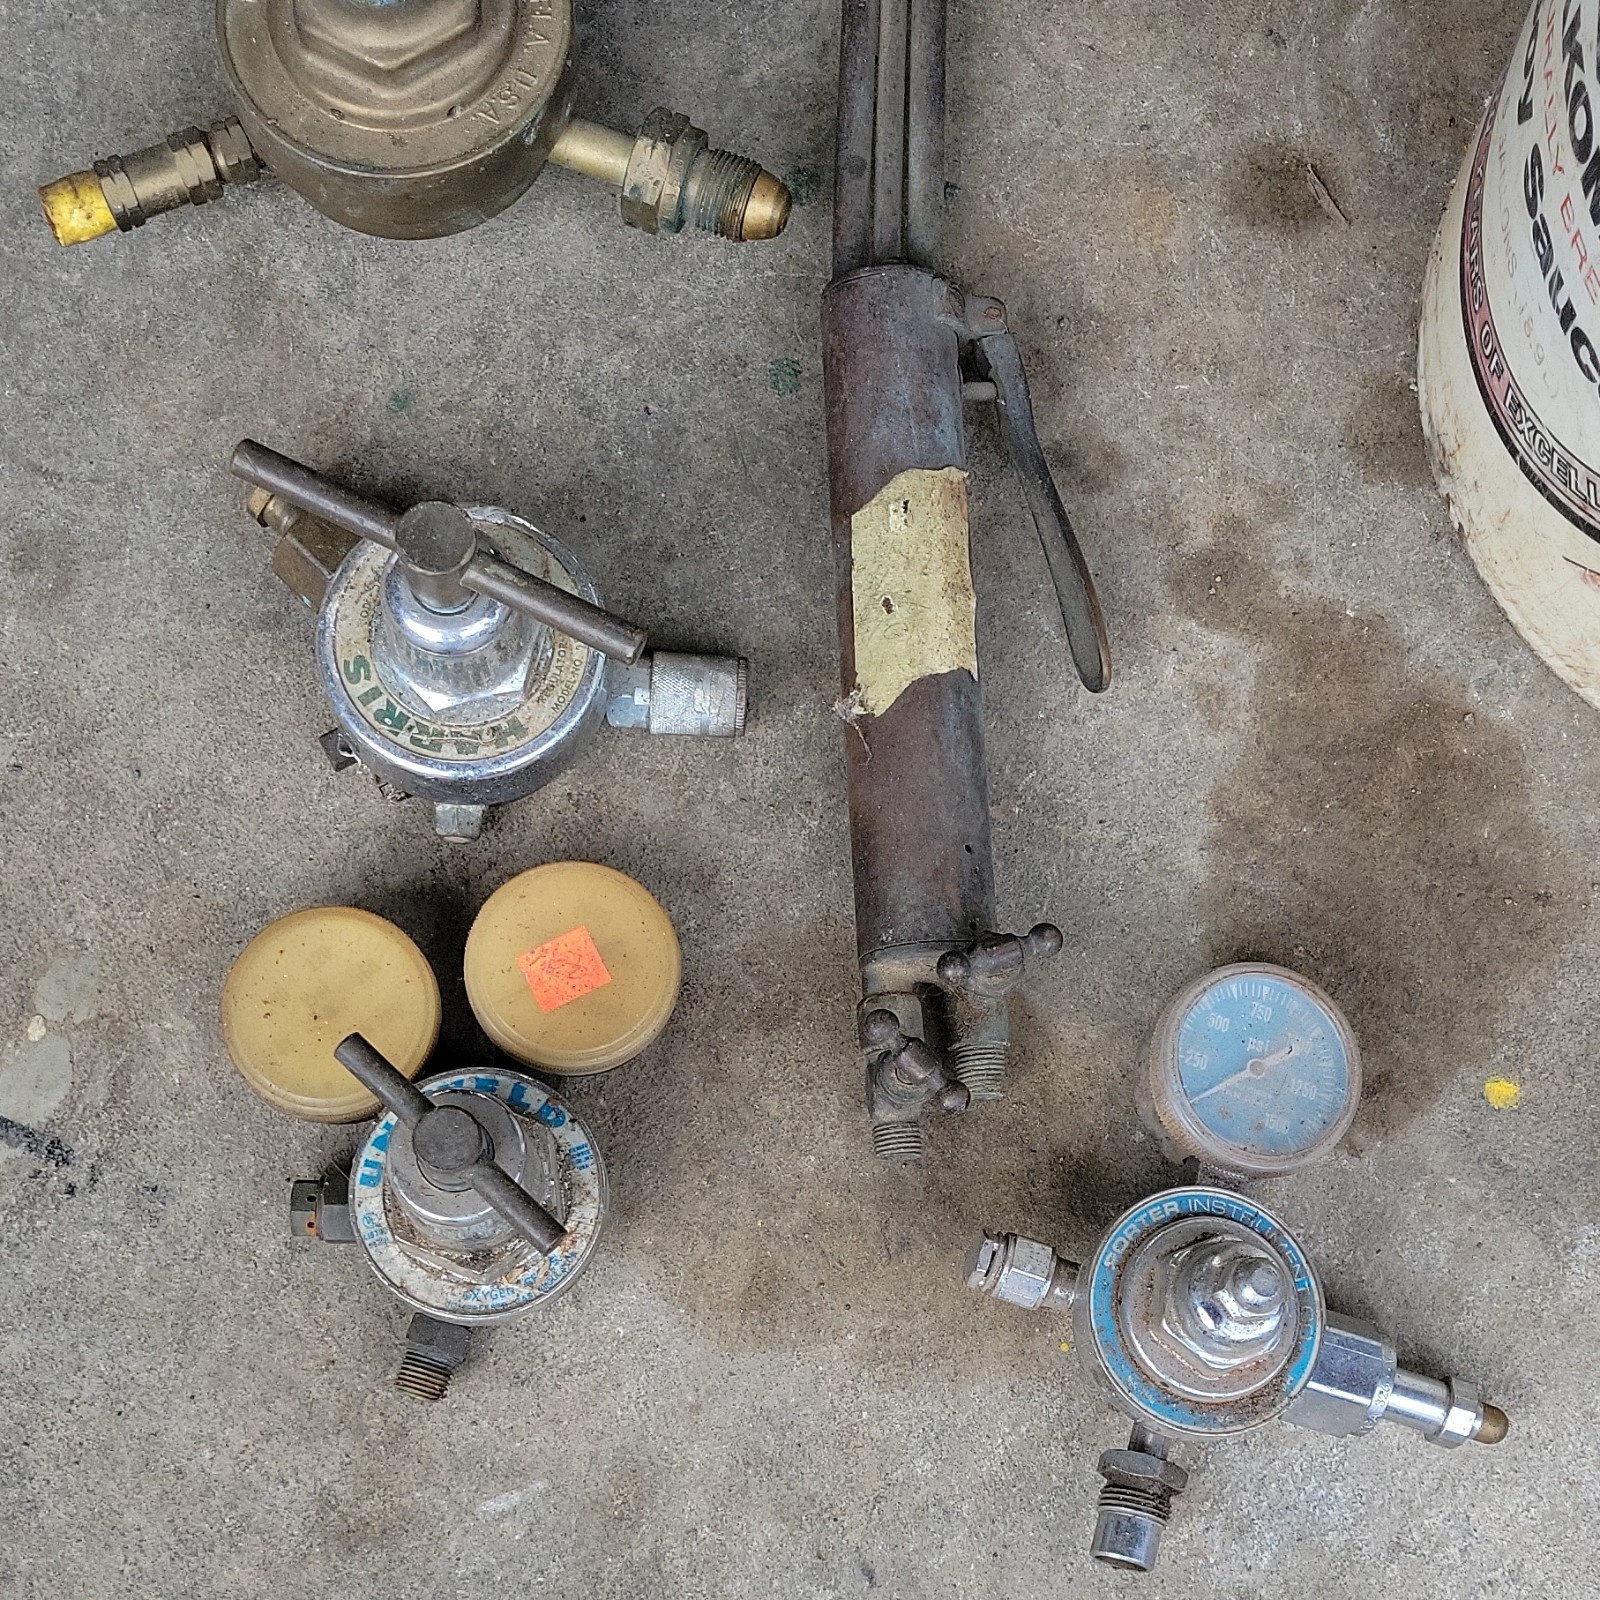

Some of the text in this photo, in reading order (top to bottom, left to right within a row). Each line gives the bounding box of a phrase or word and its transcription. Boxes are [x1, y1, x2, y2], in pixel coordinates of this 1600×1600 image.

[1523, 143, 1600, 400] Sauc
[1480, 319, 1504, 381] OF
[1104, 1200, 1180, 1270] PORTER
